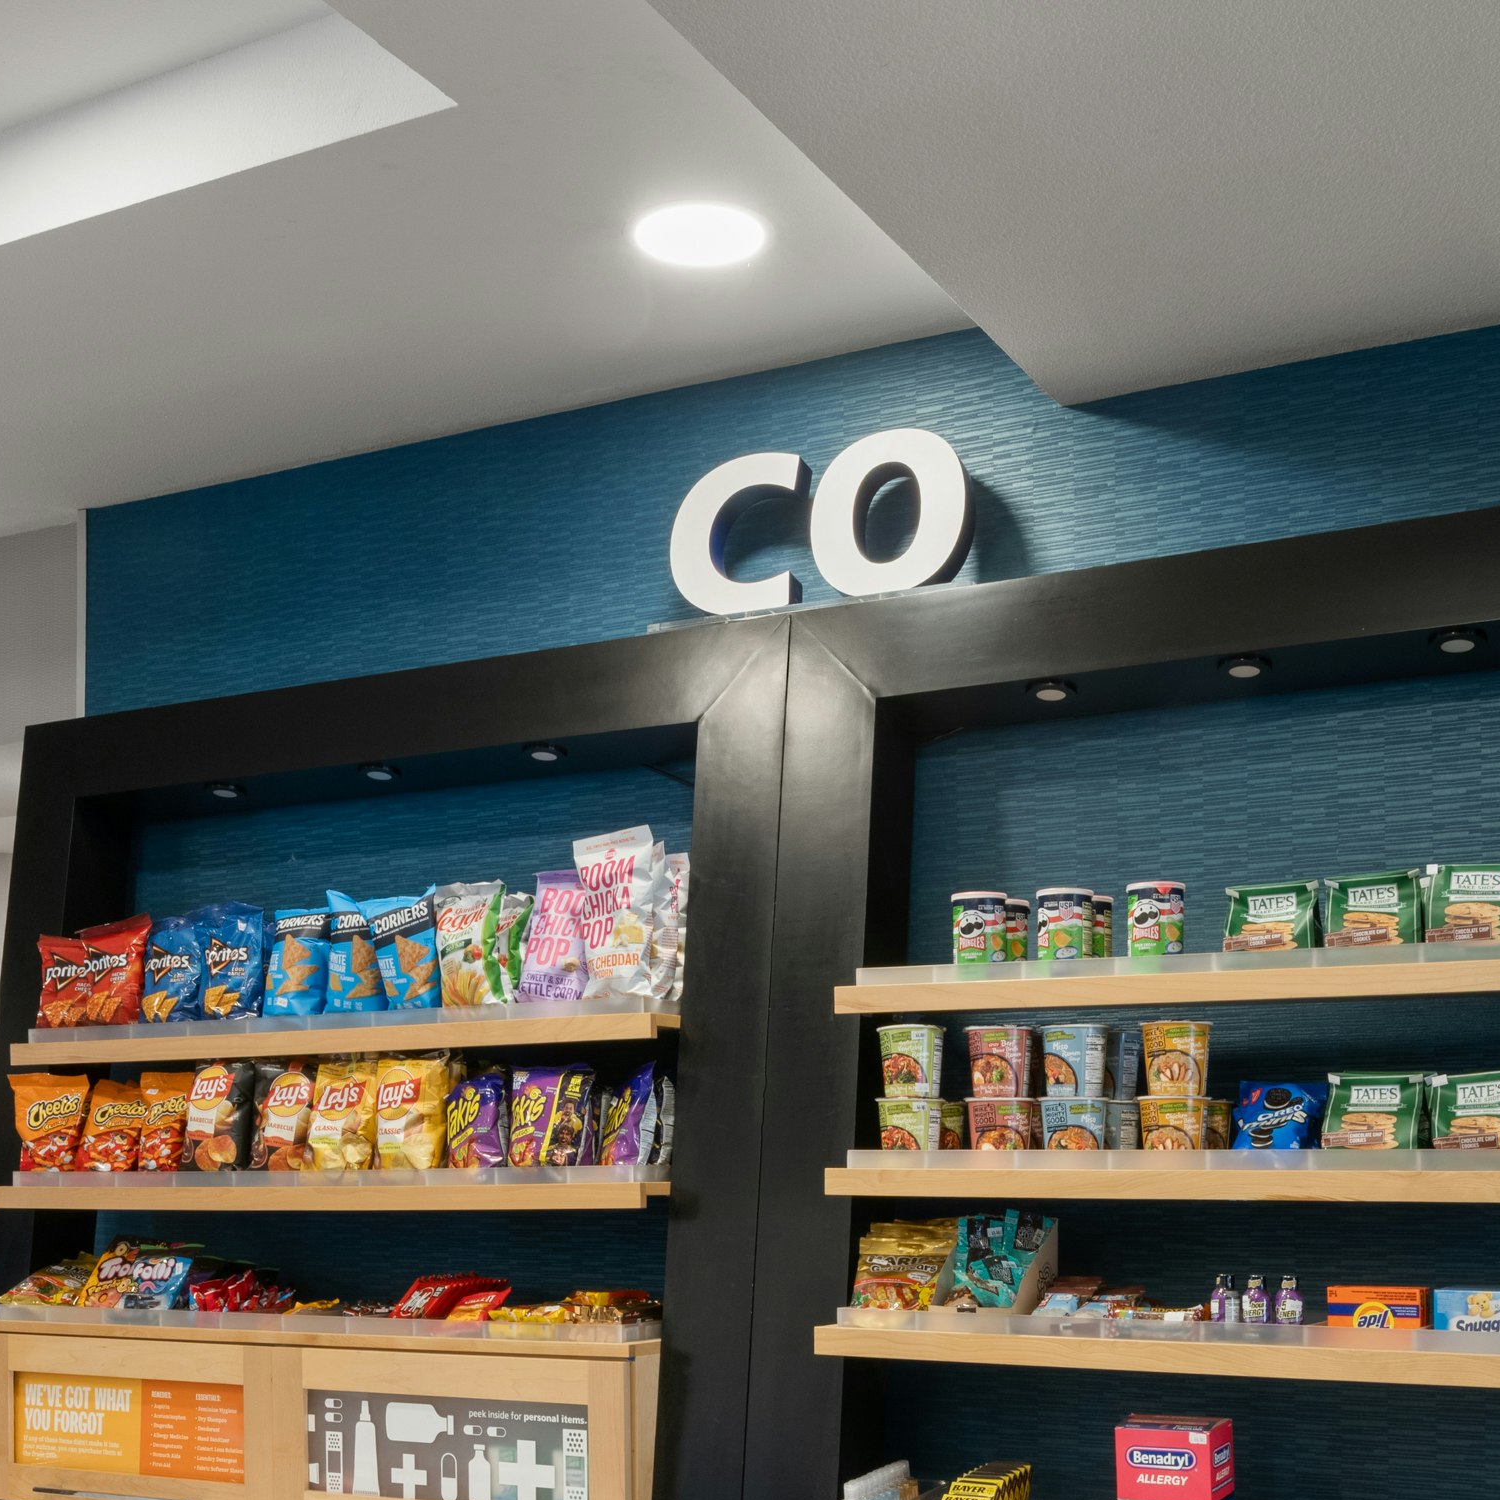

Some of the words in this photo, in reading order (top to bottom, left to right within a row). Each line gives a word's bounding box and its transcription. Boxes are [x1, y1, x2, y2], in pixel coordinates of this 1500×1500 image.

[669, 428, 975, 615] CO
[580, 855, 634, 892] BOOM
[1454, 874, 1500, 886] TATE'S
[1350, 887, 1396, 903] TATE'S
[581, 886, 632, 921] CHICKA
[1250, 896, 1294, 911] TATE'S
[581, 917, 614, 950] POP
[1132, 927, 1160, 941] PRINGLES
[959, 936, 986, 950] PRINGLES
[526, 937, 570, 968] POP
[595, 954, 640, 970] CHEDDAR
[46, 964, 87, 982] Dorito
[525, 973, 546, 982] SWEET
[548, 976, 554, 984] &
[555, 977, 574, 986] SALTY
[554, 985, 582, 999] CORN
[190, 1075, 227, 1101] Lay's
[267, 1082, 309, 1108] Lay's
[378, 1080, 416, 1110] Lay's
[1354, 1087, 1398, 1100] TATE'S
[318, 1083, 359, 1111] Lay's
[26, 1094, 81, 1130] Cheetos
[94, 1099, 148, 1125] Cheetos
[447, 1090, 481, 1140] Takis
[512, 1094, 545, 1128] Takis
[975, 1103, 994, 1112] MIKE'S
[1046, 1103, 1065, 1113] MIKE'S
[1257, 1105, 1303, 1122] OREO
[190, 1116, 214, 1125] BARBECUE
[314, 1124, 339, 1132] CLASSIC
[1047, 1116, 1066, 1124] GOOD
[378, 1126, 401, 1135] CLASSIC
[25, 1384, 62, 1407] WE'VE
[65, 1386, 91, 1409] GOT
[94, 1388, 132, 1412] WHAT
[25, 1408, 51, 1431] YOU
[54, 1410, 104, 1435] FORGOT
[468, 1409, 486, 1419] peek
[488, 1411, 509, 1420] inside
[511, 1411, 522, 1420] for
[523, 1414, 559, 1423] personal
[561, 1415, 587, 1425] items.
[1133, 1450, 1189, 1470] Benadryl
[1136, 1474, 1189, 1486] ALLERGY
[952, 1484, 986, 1493] BAYER
